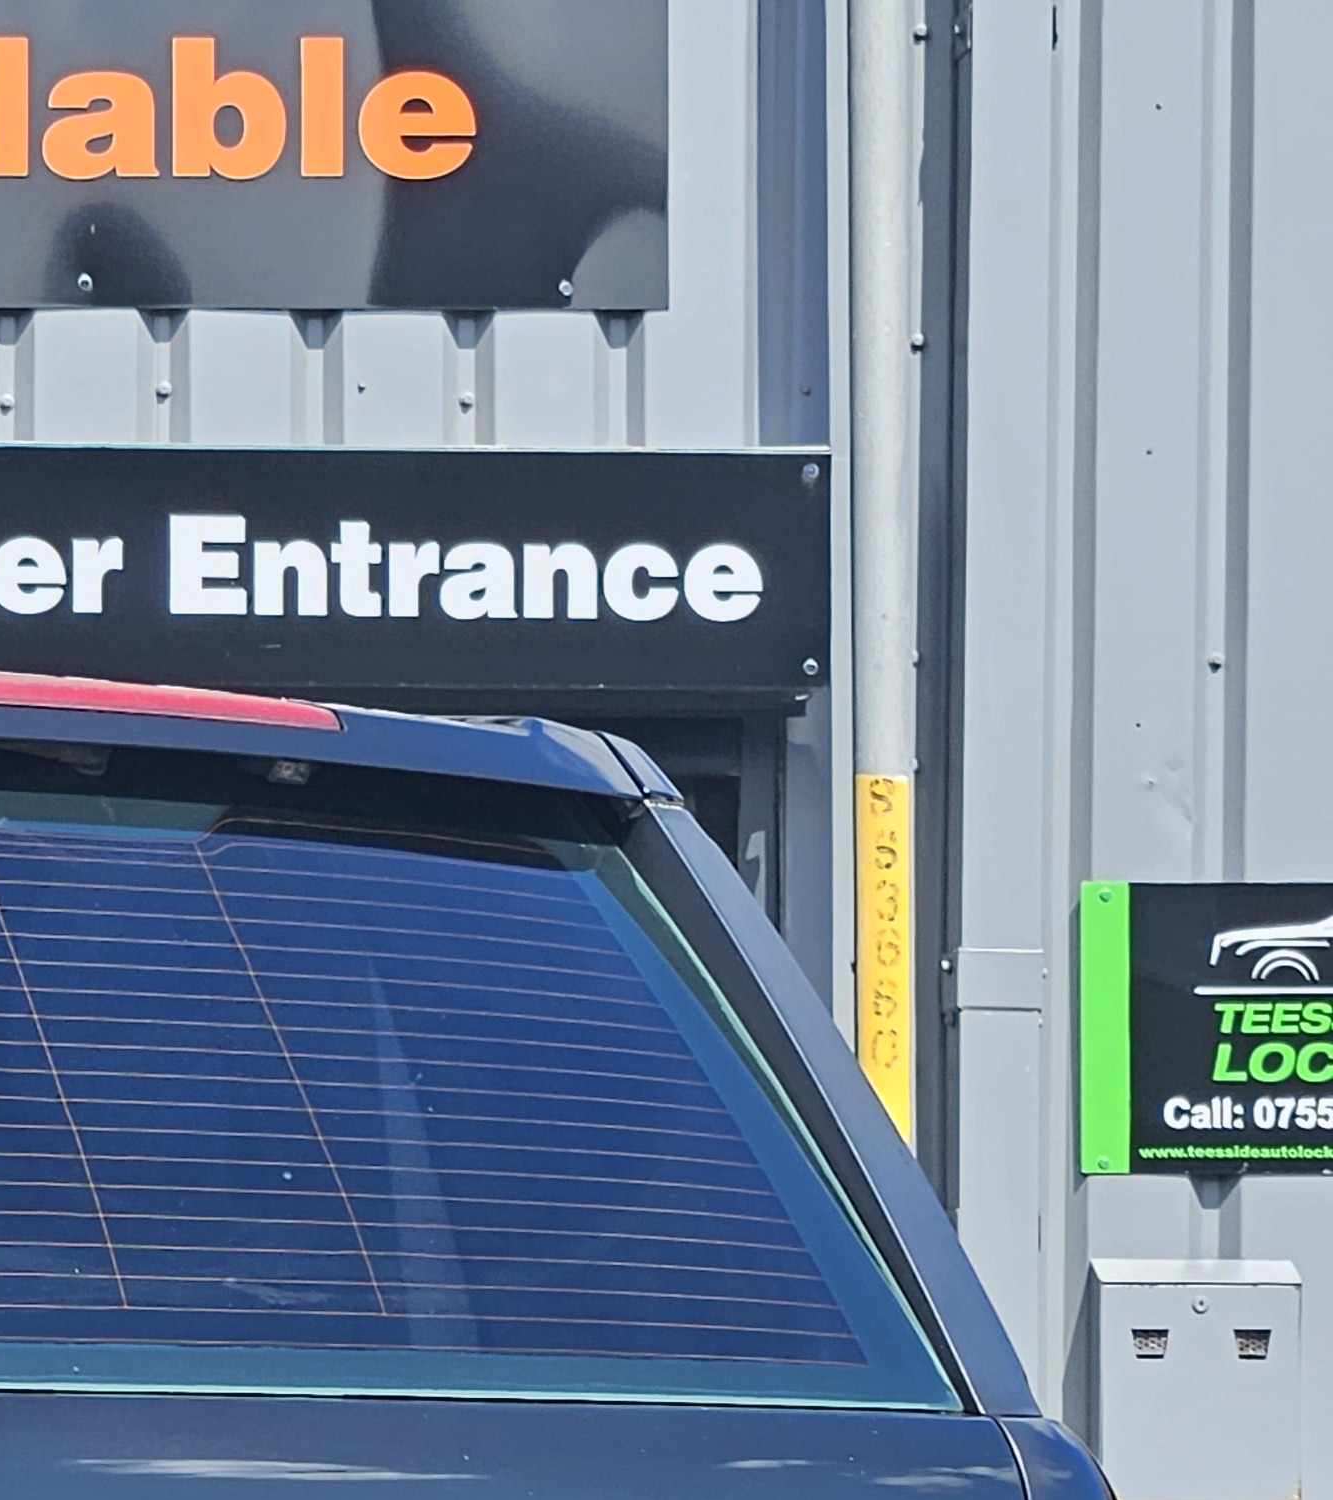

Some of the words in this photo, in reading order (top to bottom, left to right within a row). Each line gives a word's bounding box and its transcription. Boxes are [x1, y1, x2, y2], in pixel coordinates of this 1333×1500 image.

[169, 514, 764, 622] Entrance
[1214, 1002, 1333, 1034] TEES
[1163, 1096, 1245, 1130] Call:
